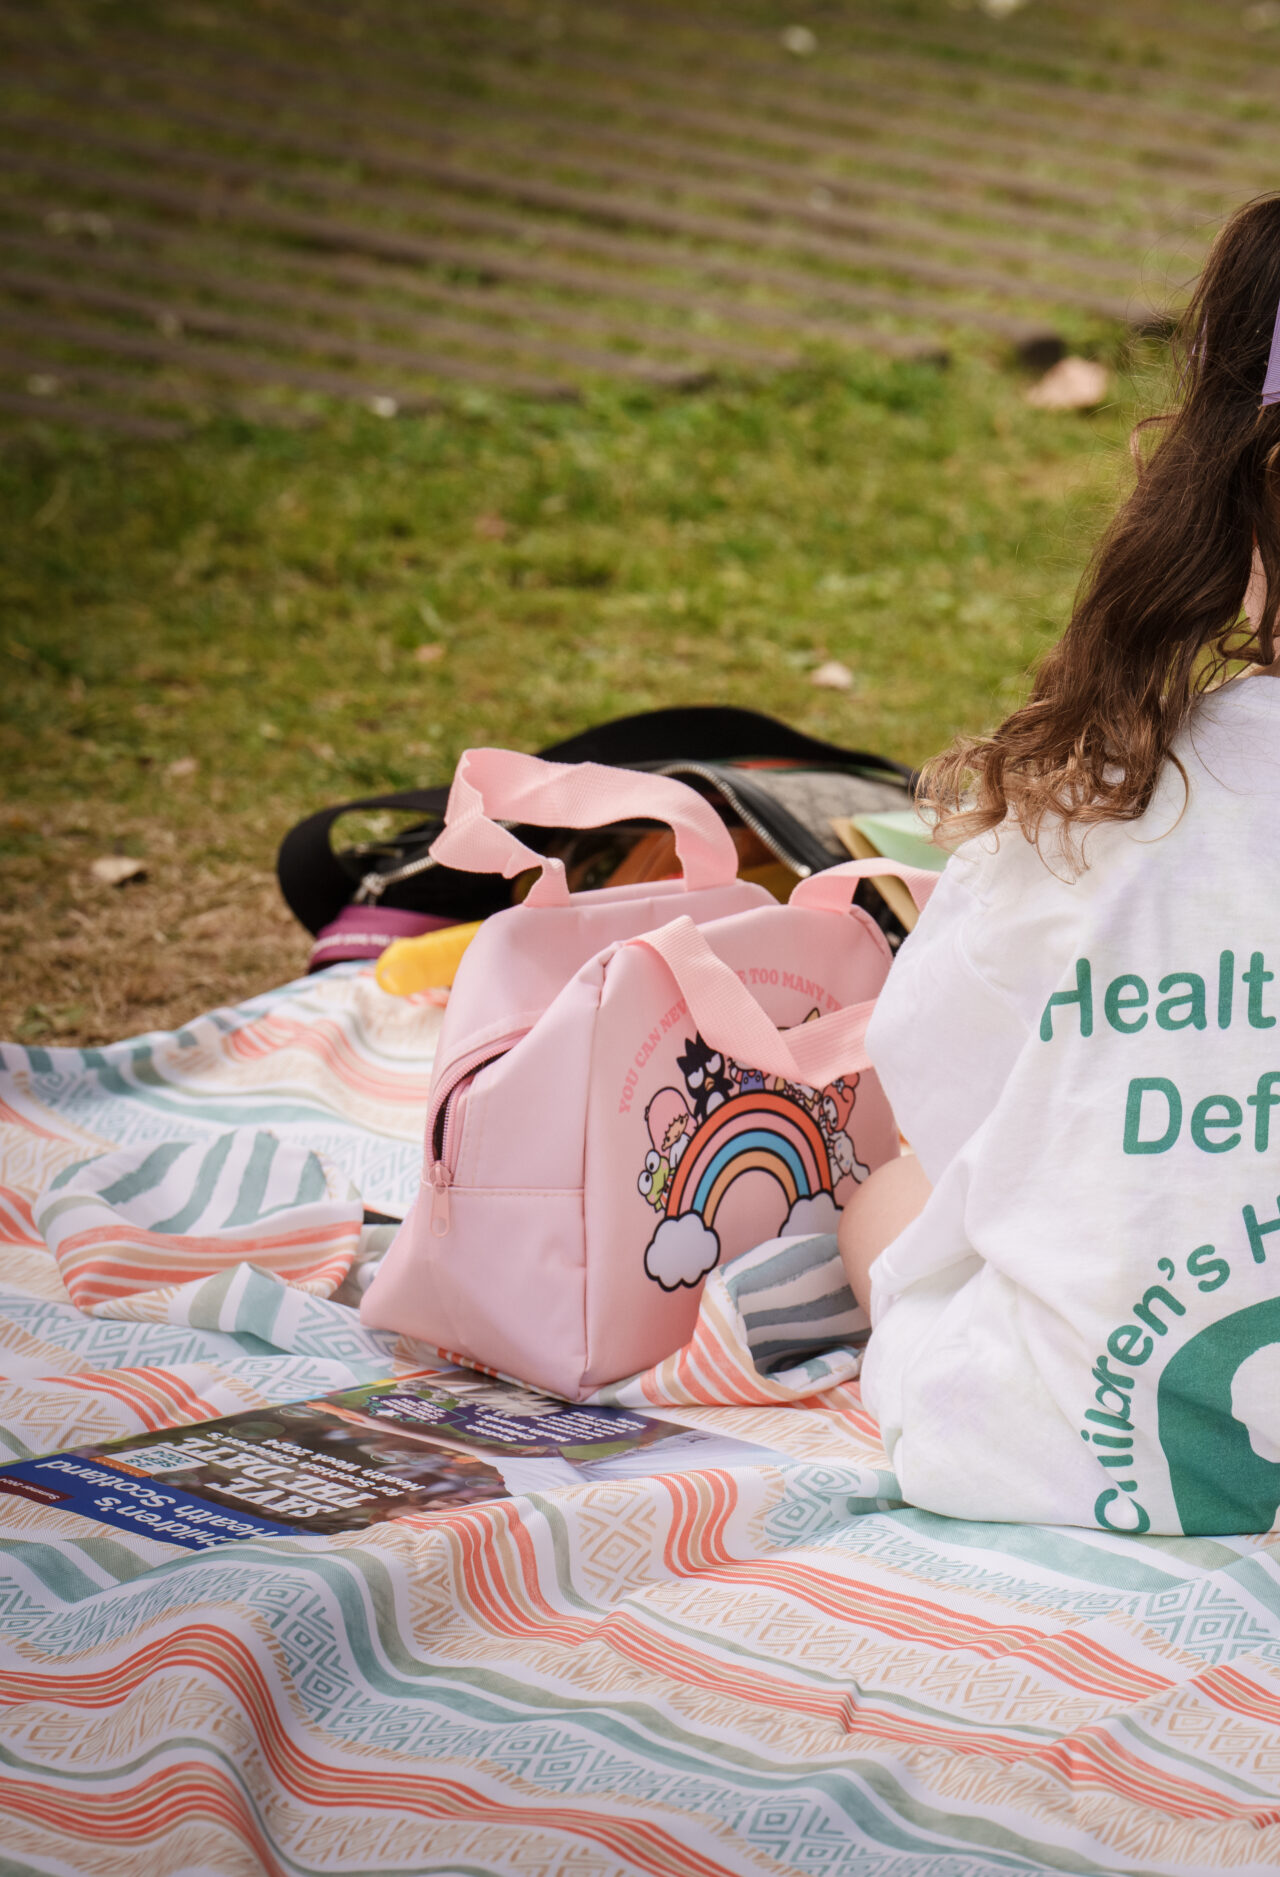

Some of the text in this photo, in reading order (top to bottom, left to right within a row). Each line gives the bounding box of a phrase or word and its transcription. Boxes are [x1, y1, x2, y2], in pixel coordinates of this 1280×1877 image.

[619, 1068, 639, 1114] YOU
[635, 1028, 662, 1068] CAN
[659, 1000, 687, 1033] NEV
[749, 968, 778, 985] TOO
[782, 971, 825, 1001] MANY
[158, 1437, 378, 1508] THE DATE
[206, 1432, 404, 1497] for Scottish Children's
[261, 1438, 426, 1491] Health Week 2024
[35, 1460, 278, 1539] Health Scotland
[94, 1496, 236, 1547] Children's
[204, 1478, 339, 1518] SAVE
